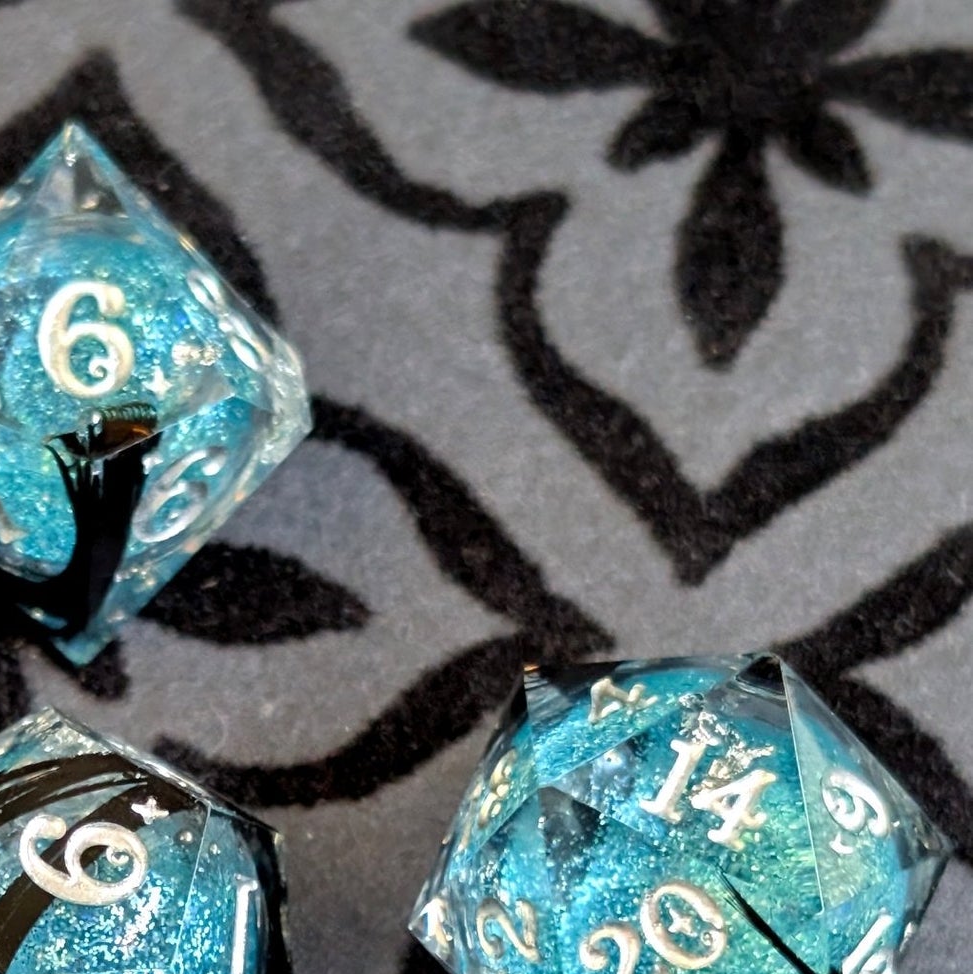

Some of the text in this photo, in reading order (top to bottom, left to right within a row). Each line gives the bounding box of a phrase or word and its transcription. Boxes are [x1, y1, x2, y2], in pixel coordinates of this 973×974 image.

[37, 280, 134, 398] 6
[639, 735, 777, 852] 14
[18, 814, 149, 906] 6
[474, 898, 539, 964] 2
